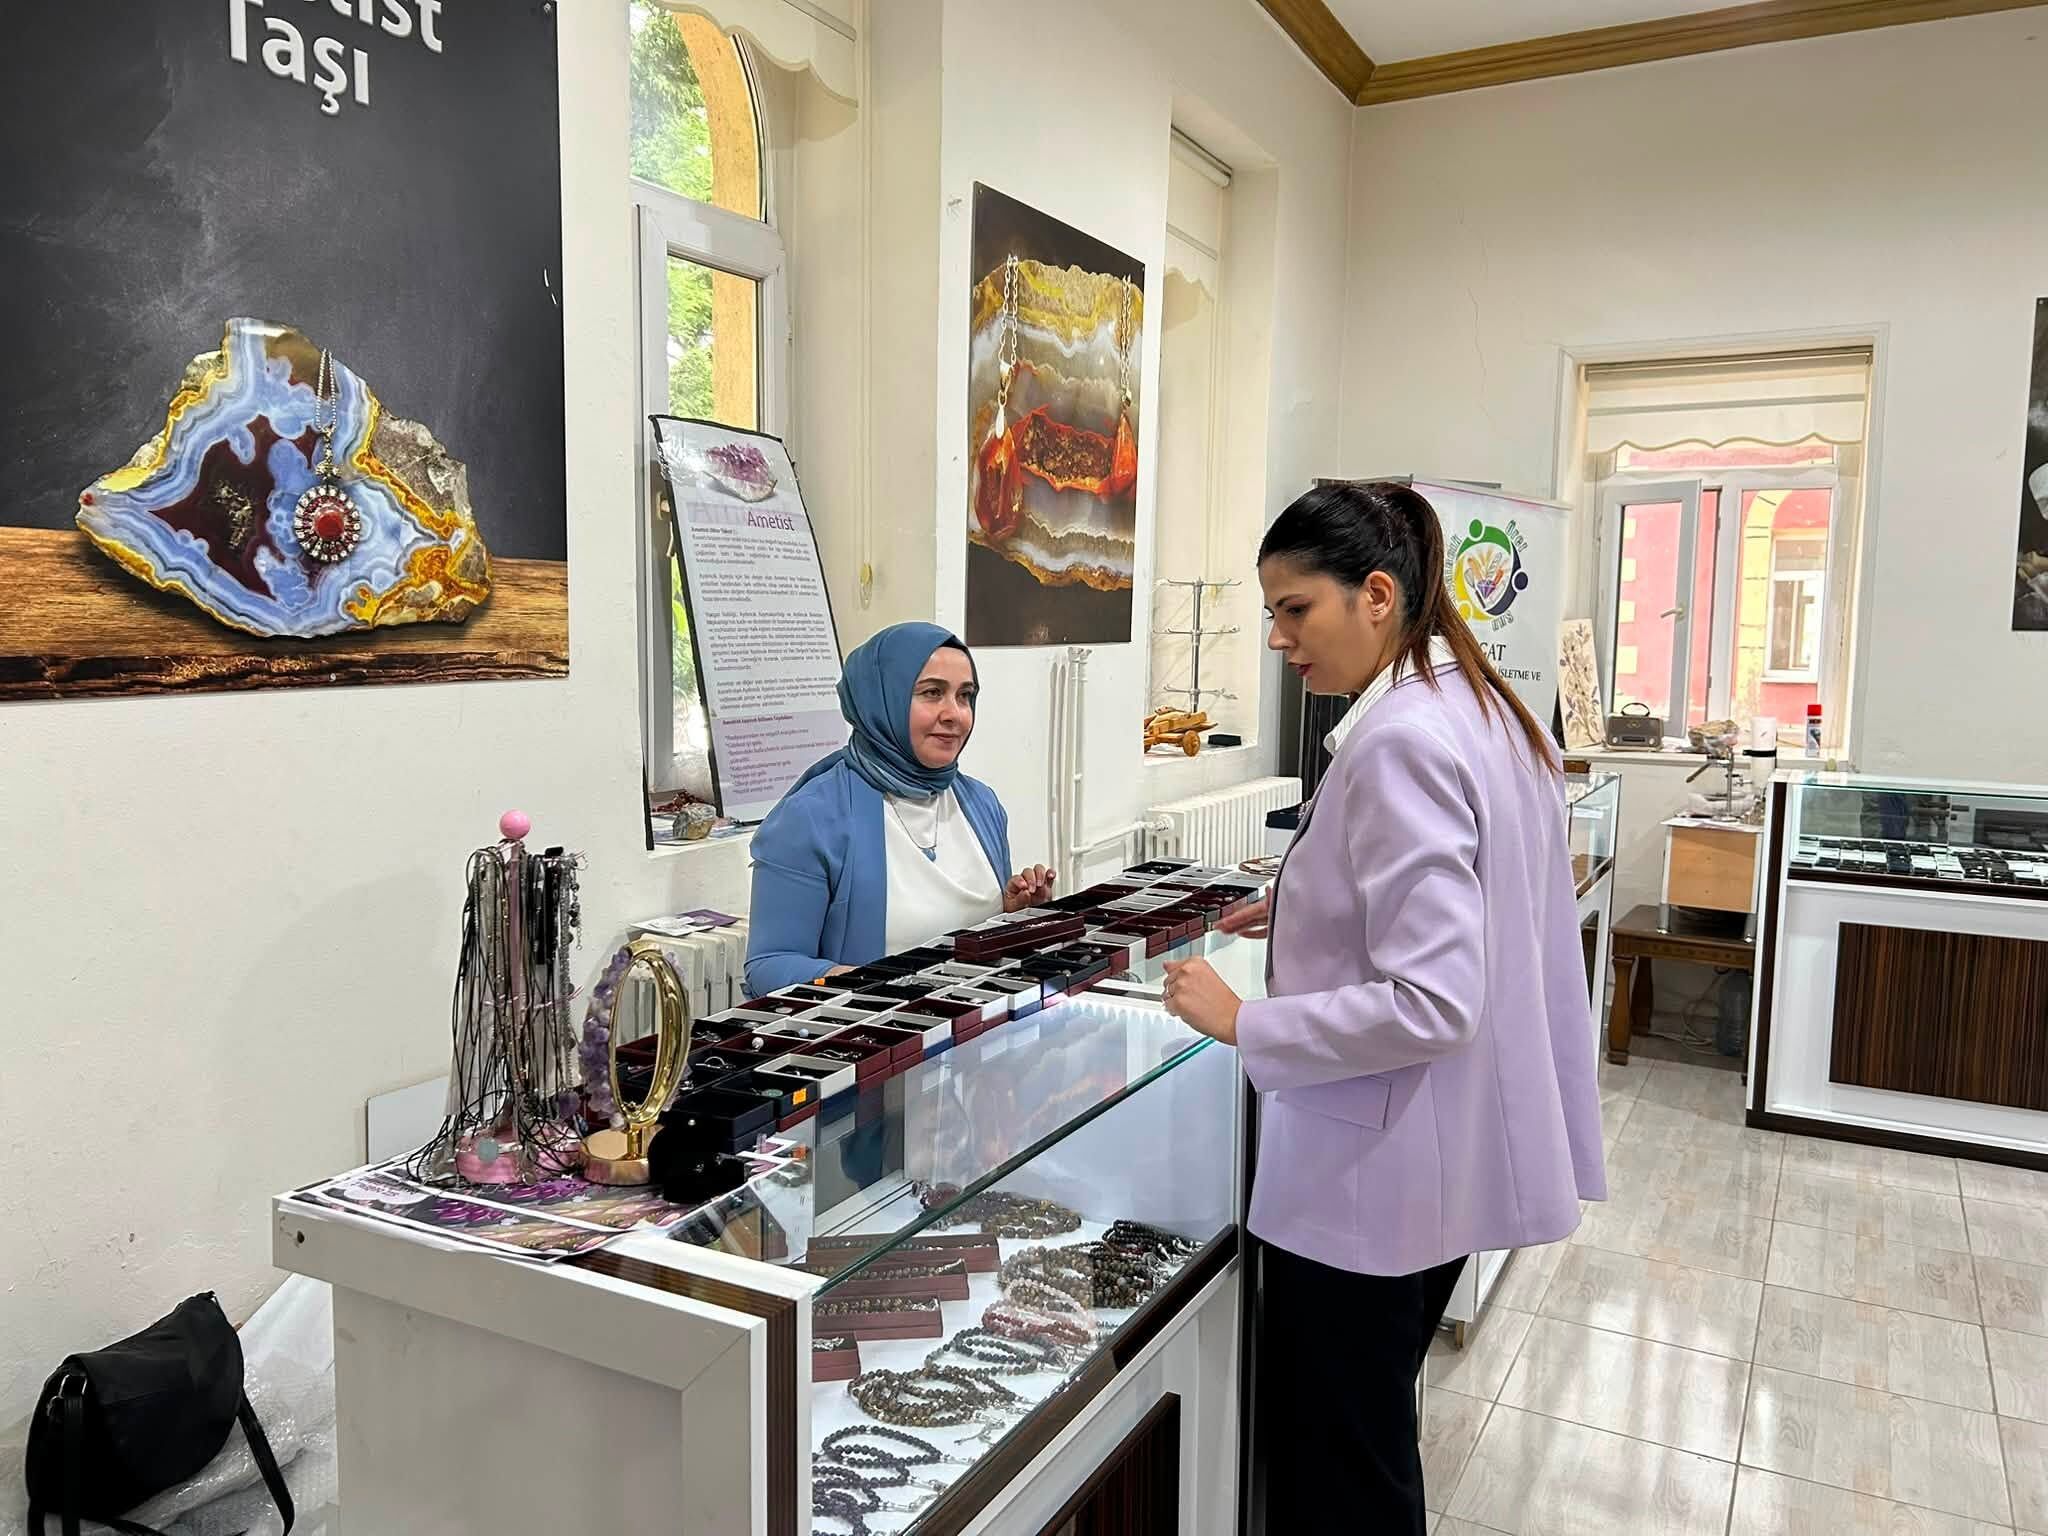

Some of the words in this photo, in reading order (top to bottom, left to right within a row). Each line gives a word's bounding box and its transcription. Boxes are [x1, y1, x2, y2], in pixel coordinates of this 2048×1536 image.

[229, 0, 370, 115] Taşı
[747, 511, 795, 531] Ametist
[1531, 670, 1541, 681] VE
